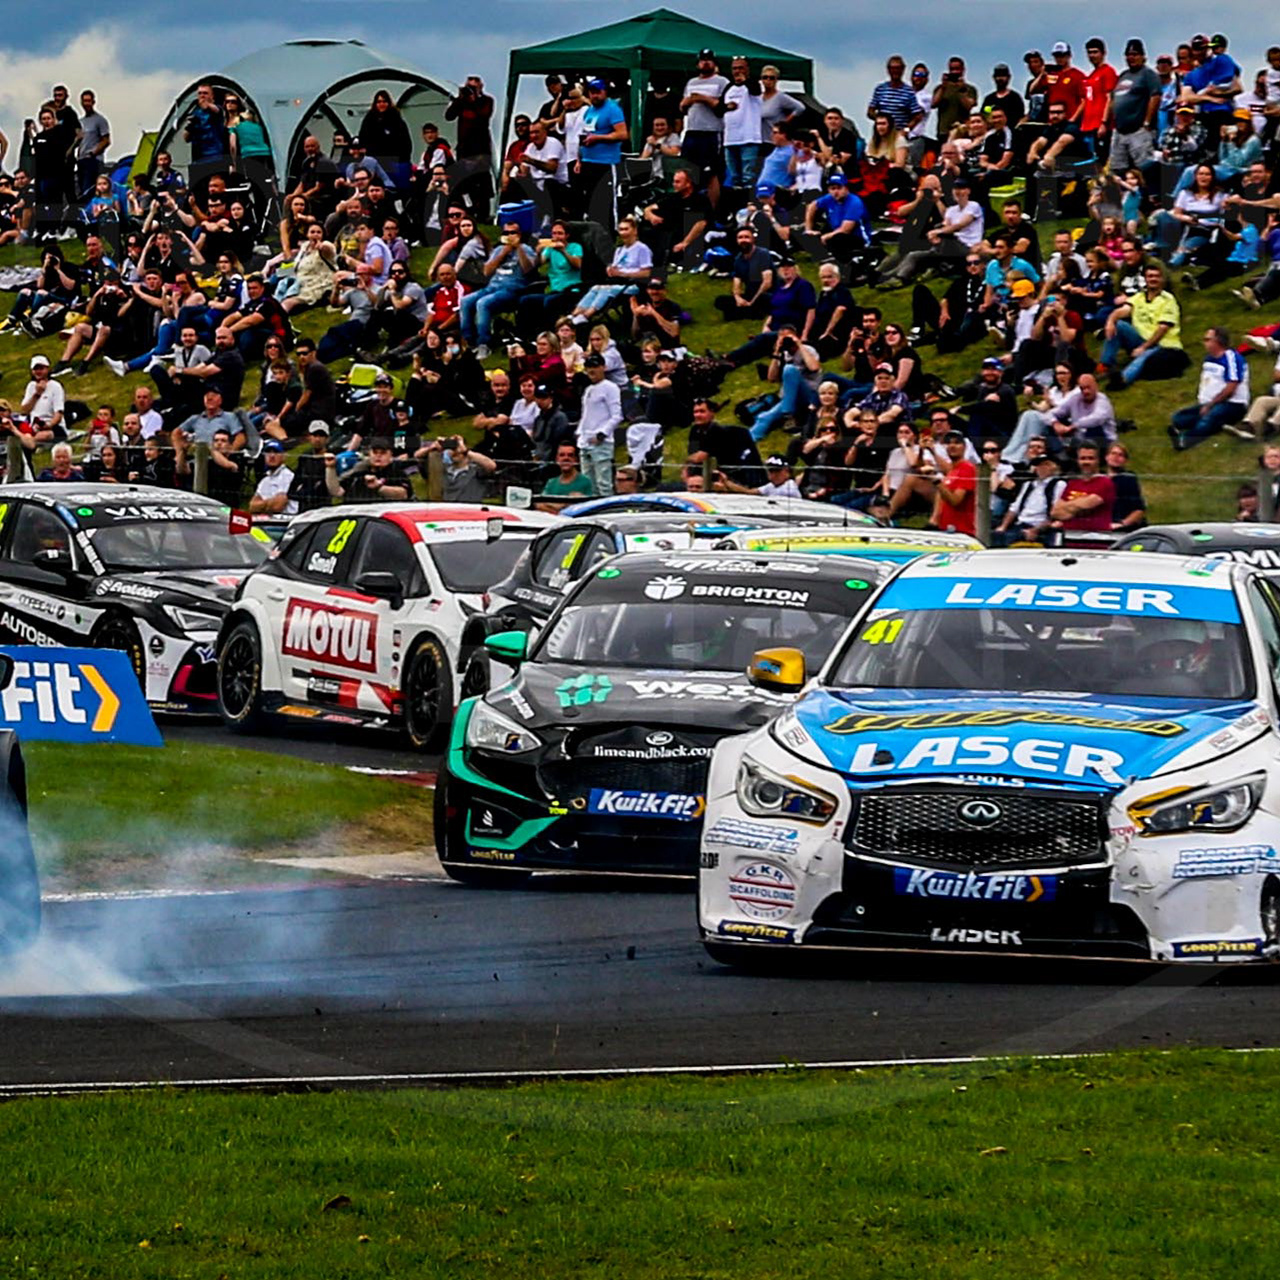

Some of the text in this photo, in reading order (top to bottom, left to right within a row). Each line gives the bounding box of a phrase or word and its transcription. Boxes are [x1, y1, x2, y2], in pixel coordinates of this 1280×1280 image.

[326, 519, 357, 554] 23
[692, 585, 810, 603] BRIGHTON
[945, 583, 1180, 615] LASER
[285, 604, 374, 664] MOTUL
[862, 618, 905, 645] 41
[849, 735, 1126, 786] LASER
[745, 865, 784, 882] GKR
[728, 883, 796, 902] SCAFFOLDING
[723, 922, 788, 938] GOODYEAR
[1180, 940, 1257, 954] GOODYEAR
